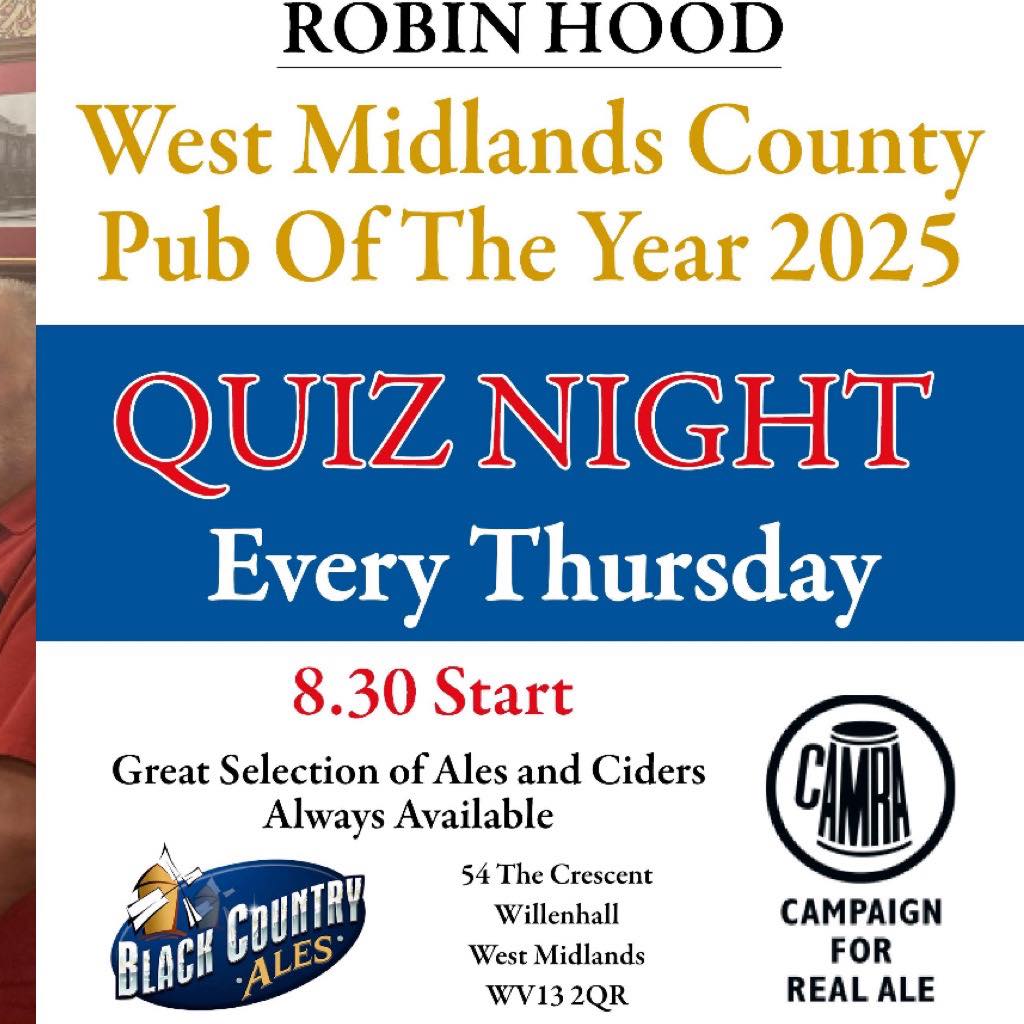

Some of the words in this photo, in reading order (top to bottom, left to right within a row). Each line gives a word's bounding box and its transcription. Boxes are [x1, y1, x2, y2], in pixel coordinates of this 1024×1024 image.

[283, 2, 526, 55] ROBIN
[544, 2, 783, 55] HOOD
[75, 103, 272, 176] West
[292, 96, 663, 176] Midlands
[688, 102, 986, 201] County
[98, 205, 250, 282] Pub
[276, 205, 391, 282] Of
[401, 205, 556, 281] The
[577, 211, 750, 282] Year
[770, 212, 961, 288] 2025
[113, 370, 453, 499] QUIZ
[477, 369, 934, 471] NIGHT
[208, 528, 450, 628] Every
[470, 521, 882, 628] Thursday
[293, 668, 416, 719] 8.30
[434, 667, 573, 716] Start
[112, 754, 210, 786] Great
[220, 752, 380, 785] Selection
[389, 752, 429, 785] of
[432, 752, 507, 785] Ales
[517, 752, 582, 785] and
[592, 752, 705, 785] Ciders
[795, 741, 911, 846] CAMRA
[262, 797, 384, 838] Always
[393, 797, 554, 829] Available
[461, 862, 490, 886] 54
[496, 862, 543, 885] The
[550, 863, 653, 885] Crescent
[493, 903, 619, 925] Willenhall
[780, 898, 942, 926] CAMPAIGN
[118, 928, 214, 997] BLACK
[226, 877, 363, 964] COUNTRY
[468, 944, 527, 965] West
[533, 942, 645, 965] Midlands
[831, 936, 892, 964] FOR
[241, 935, 334, 1001] ALES
[787, 975, 869, 1002] REAL
[878, 975, 935, 1002] ALE
[485, 985, 565, 1006] WV13
[570, 985, 629, 1012] 2QR
